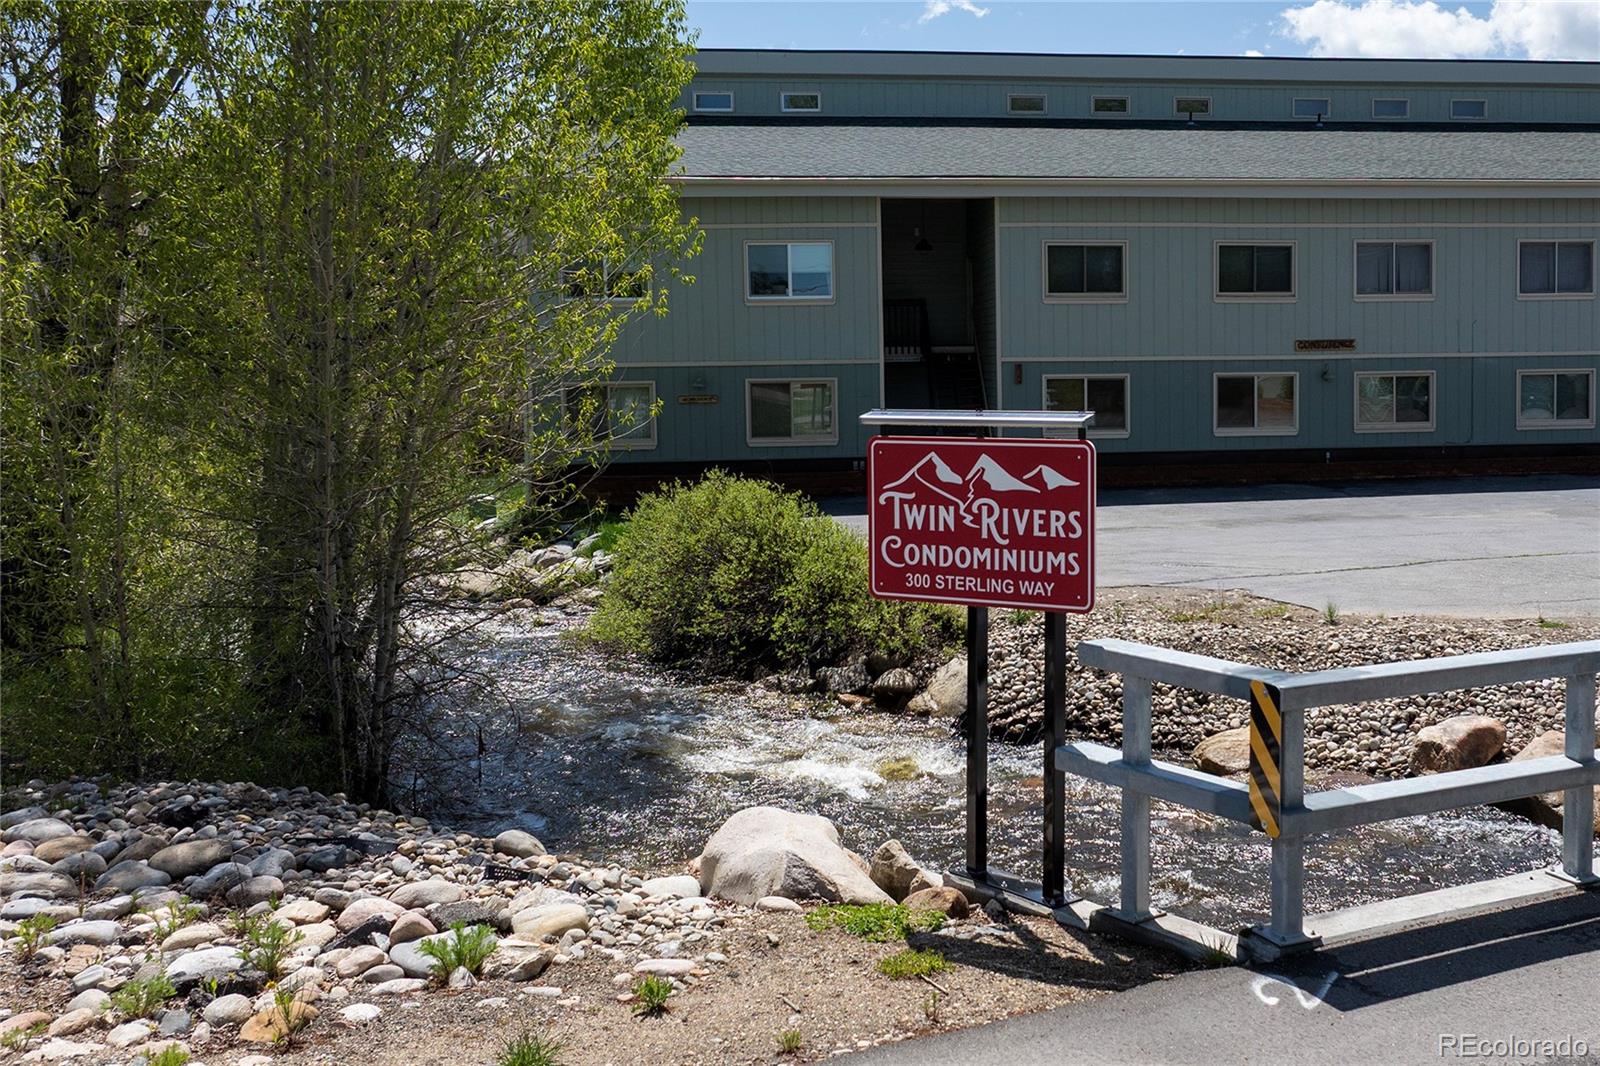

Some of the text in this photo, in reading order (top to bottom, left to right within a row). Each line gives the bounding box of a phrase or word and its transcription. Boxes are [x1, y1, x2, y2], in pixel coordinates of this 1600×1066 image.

[879, 491, 1083, 545] TWIN RIVERS
[881, 535, 1081, 576] CONDOMINIUMS
[905, 573, 1055, 597] 300 STERLING WAY
